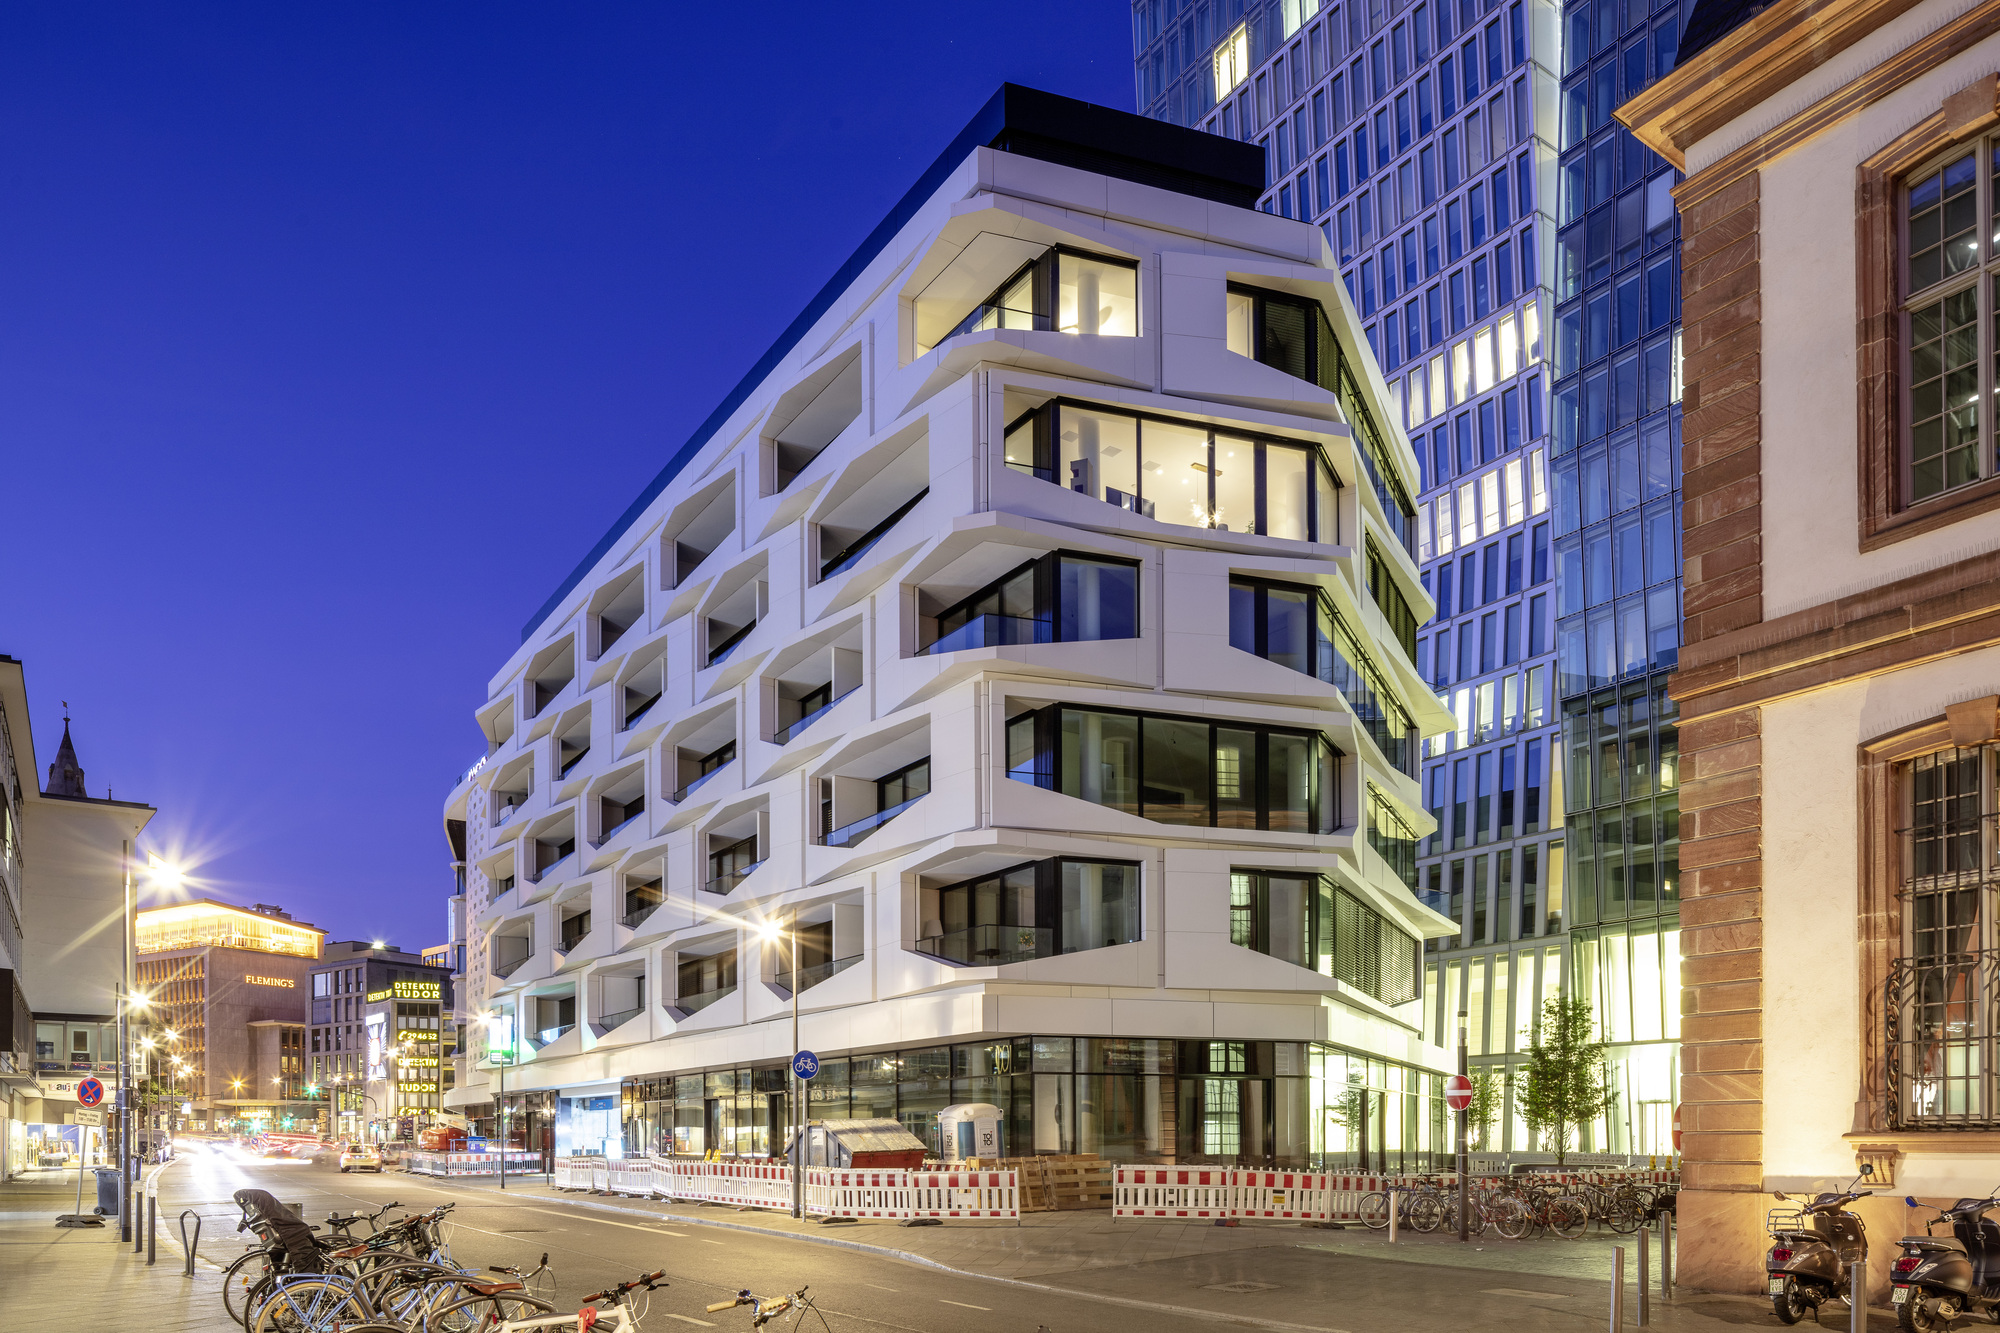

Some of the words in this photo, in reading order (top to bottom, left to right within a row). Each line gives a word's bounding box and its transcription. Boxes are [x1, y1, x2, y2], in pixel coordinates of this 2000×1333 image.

[245, 975, 294, 988] FLEMING'S
[394, 982, 440, 990] DETEKTIV
[394, 990, 440, 998] TUDOR
[398, 1058, 438, 1067] DTEKTIV
[398, 1083, 436, 1092] TUDOR
